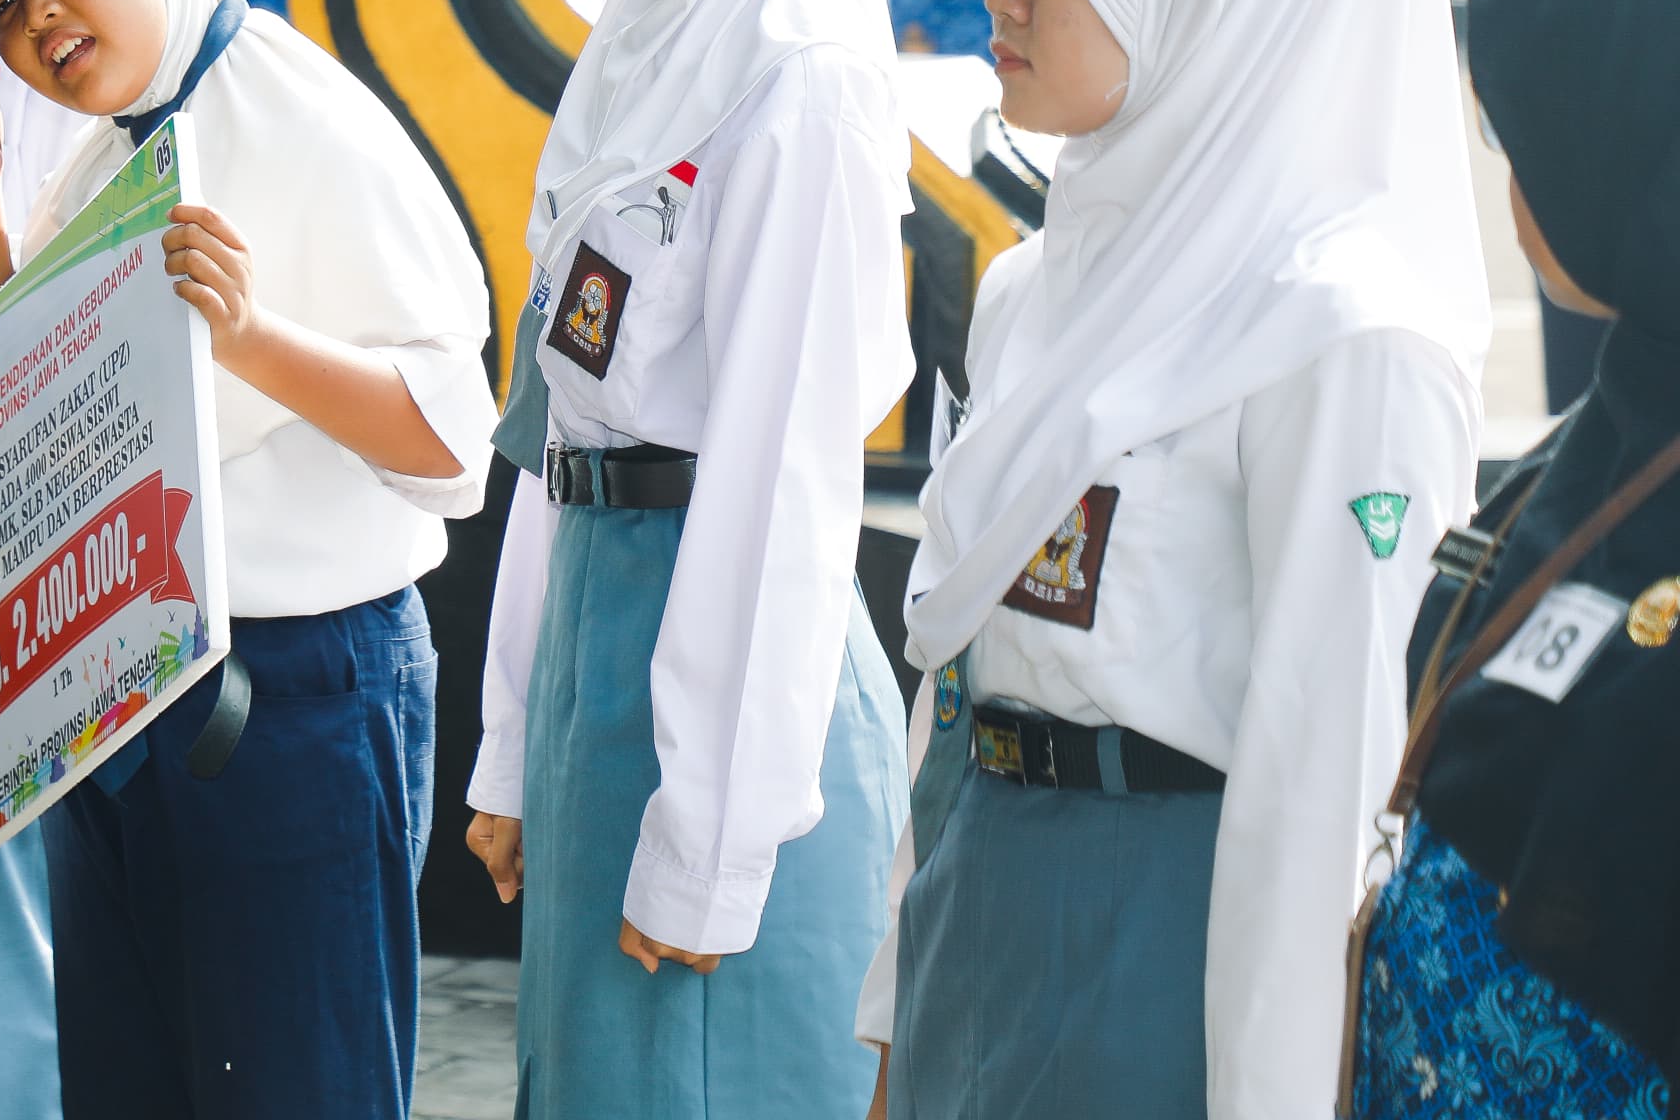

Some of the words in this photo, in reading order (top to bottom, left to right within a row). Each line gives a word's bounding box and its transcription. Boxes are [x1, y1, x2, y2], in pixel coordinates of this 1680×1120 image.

[156, 137, 171, 175] 05
[55, 314, 76, 347] DAN
[78, 244, 144, 325] KEBUDAYAAN
[32, 362, 60, 398] JAWA
[61, 315, 102, 369] TENGAH
[60, 371, 96, 425] ZAKAT
[99, 339, 131, 388] (UPZ)
[21, 490, 43, 527] SLB
[46, 401, 140, 506] NEGERI/SWASTA
[25, 453, 47, 490] 4000
[49, 383, 120, 468] SISWA/SISWI
[2, 521, 44, 579] MAMPU
[47, 496, 70, 539] DAN
[73, 420, 154, 515] BERPRESTASI
[12, 512, 146, 670] 2.400.000,-
[41, 712, 87, 764] PROVINSI
[89, 685, 117, 725] JAWA
[118, 645, 158, 697] TENGAH
[53, 677, 60, 698] 1
[60, 667, 73, 691] Th
